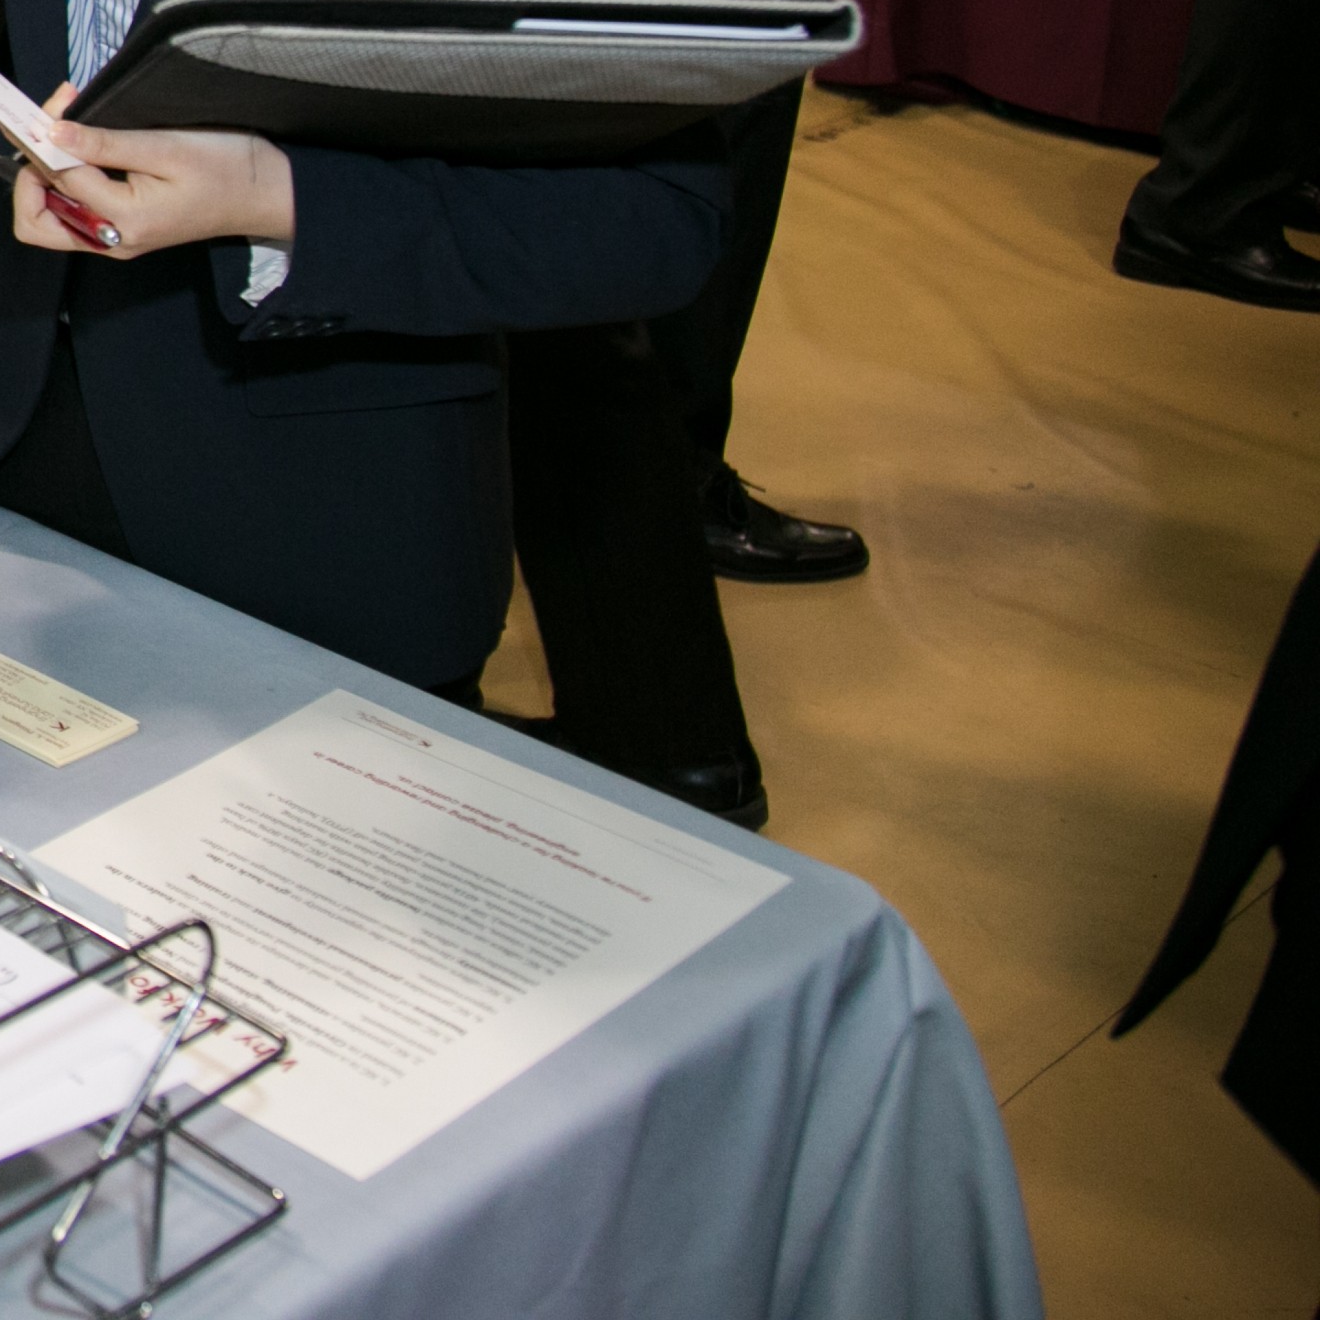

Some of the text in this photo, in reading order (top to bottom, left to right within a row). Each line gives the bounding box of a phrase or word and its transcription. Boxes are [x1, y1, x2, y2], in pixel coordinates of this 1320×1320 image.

[323, 755, 363, 775] career
[361, 771, 422, 802] rewarding
[395, 775, 582, 858] engineering, please contact us.
[420, 798, 447, 812] and
[218, 816, 262, 840] medical,
[446, 808, 522, 845] challenging
[204, 852, 224, 864] the
[259, 836, 304, 859] includes
[102, 863, 123, 877] the
[223, 861, 237, 870] to
[236, 868, 265, 884] back
[548, 853, 601, 879] looking
[121, 873, 136, 883] in
[185, 873, 233, 899] training
[265, 881, 292, 896] give
[325, 866, 375, 892] package
[134, 880, 176, 904] leaders
[141, 915, 201, 949] rewding
[251, 906, 329, 947] development
[204, 970, 283, 1013] Poughkeep
[156, 991, 230, 1035] Wok
